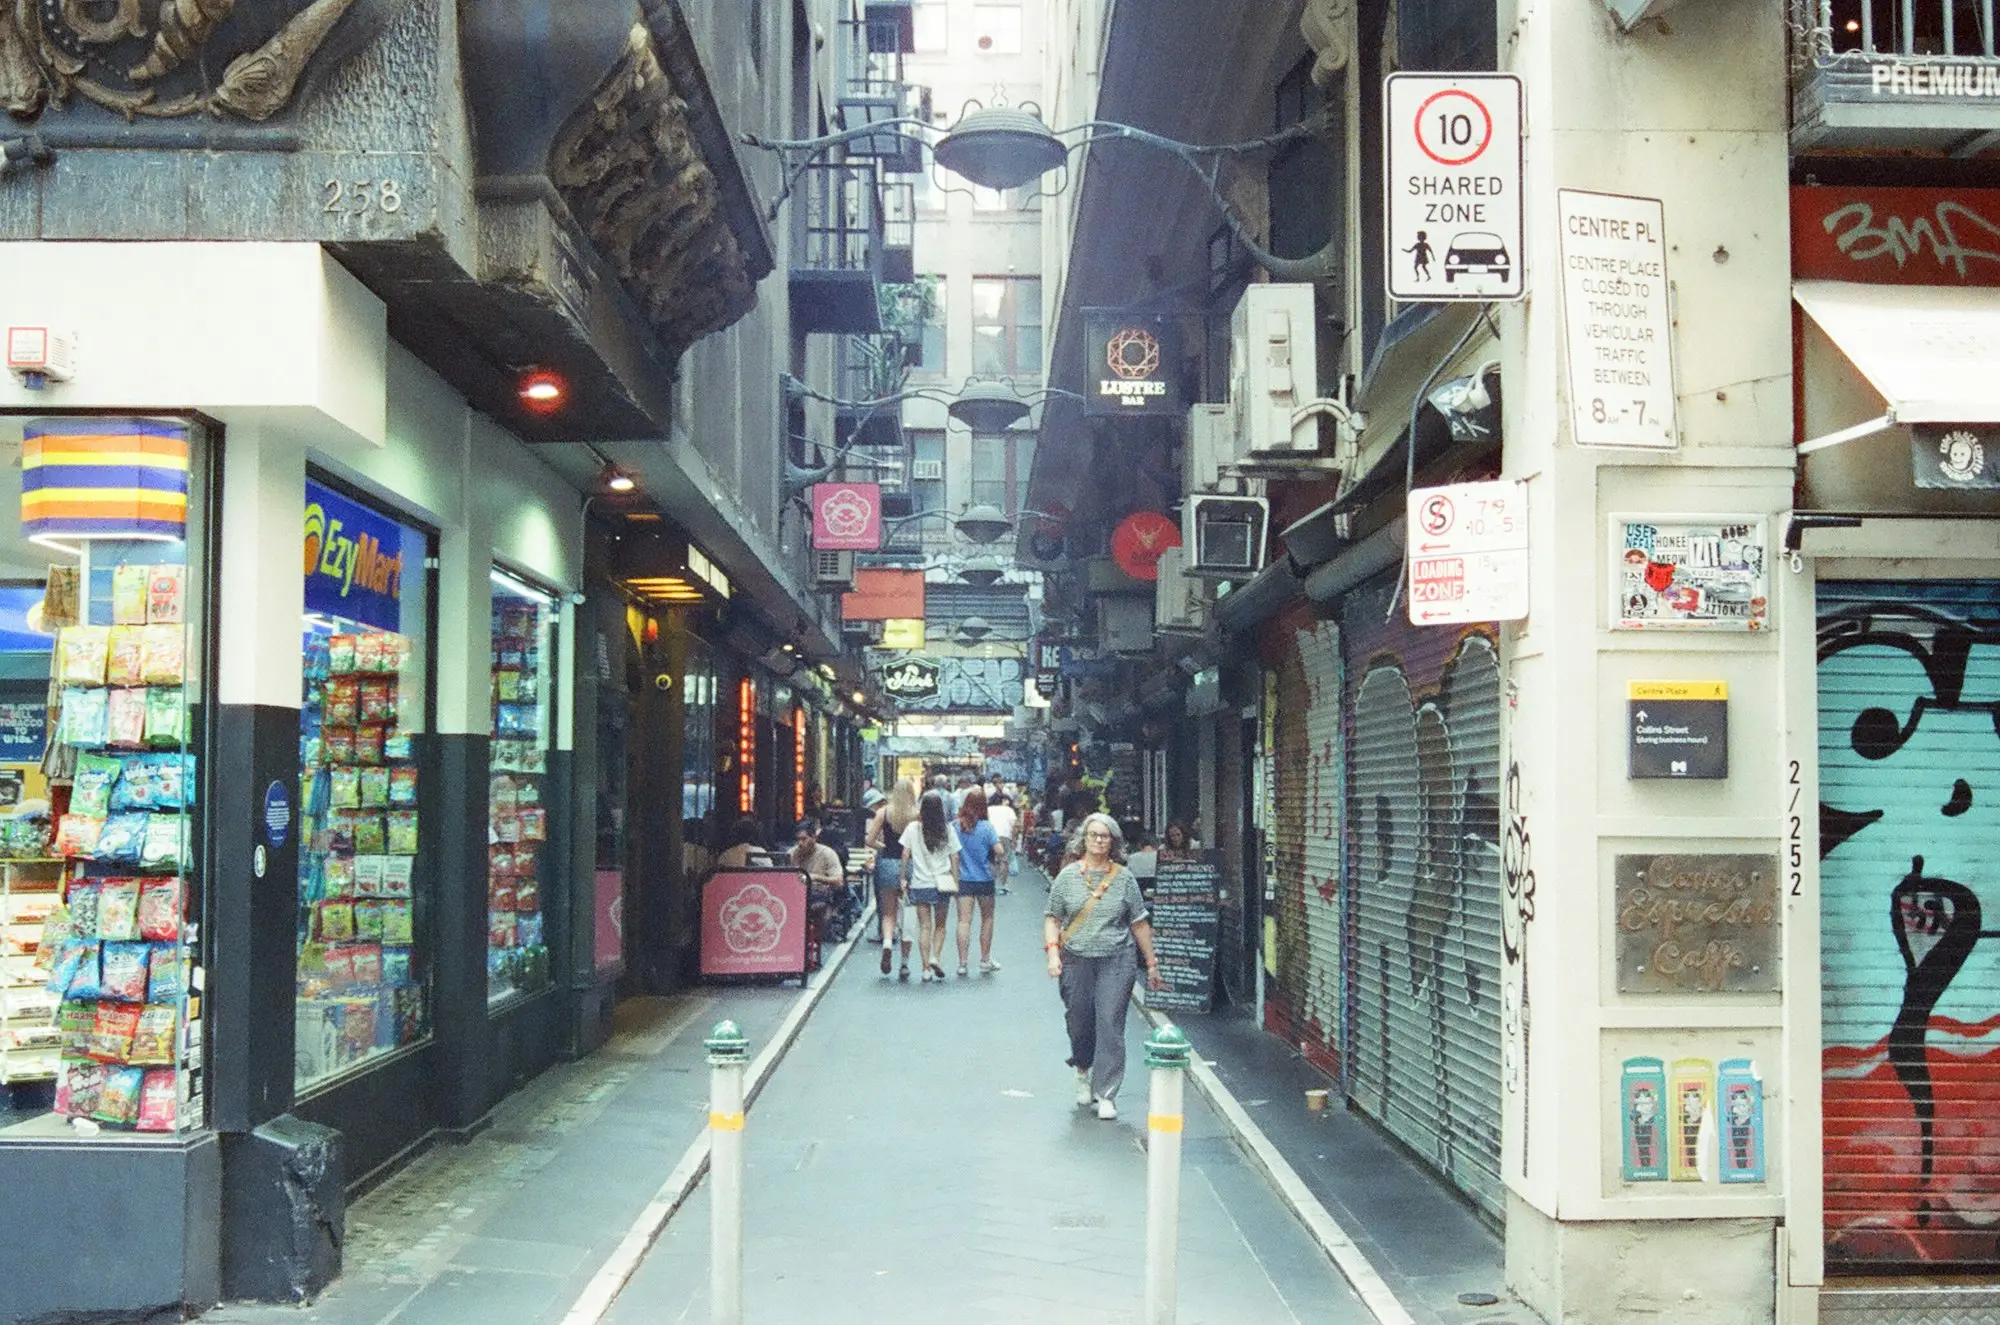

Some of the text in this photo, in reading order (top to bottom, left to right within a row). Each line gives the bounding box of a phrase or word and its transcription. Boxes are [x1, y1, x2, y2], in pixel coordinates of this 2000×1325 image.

[1439, 114, 1472, 146] 10
[1408, 176, 1503, 196] SHARED
[324, 179, 402, 215] 258
[1425, 203, 1487, 223] ZONE
[1568, 215, 1657, 244] CENTRE PL
[1568, 254, 1661, 278] CENTRE PLACE
[1582, 278, 1650, 298] CLOSED TO
[1588, 300, 1648, 320] THROUGH
[1584, 323, 1655, 344] VEHICULAR
[1595, 346, 1647, 365] TRAFFIC
[1593, 368, 1651, 387] BETWEEN
[1100, 380, 1166, 396] LUSTRE
[1121, 395, 1145, 406] BAR
[319, 519, 403, 598] EzyMart
[1415, 560, 1464, 580] LOADING
[1415, 582, 1464, 601] ZONE
[1636, 687, 1688, 695] Centre Place
[14, 727, 28, 736] TO
[1636, 725, 1689, 735] Collins Street
